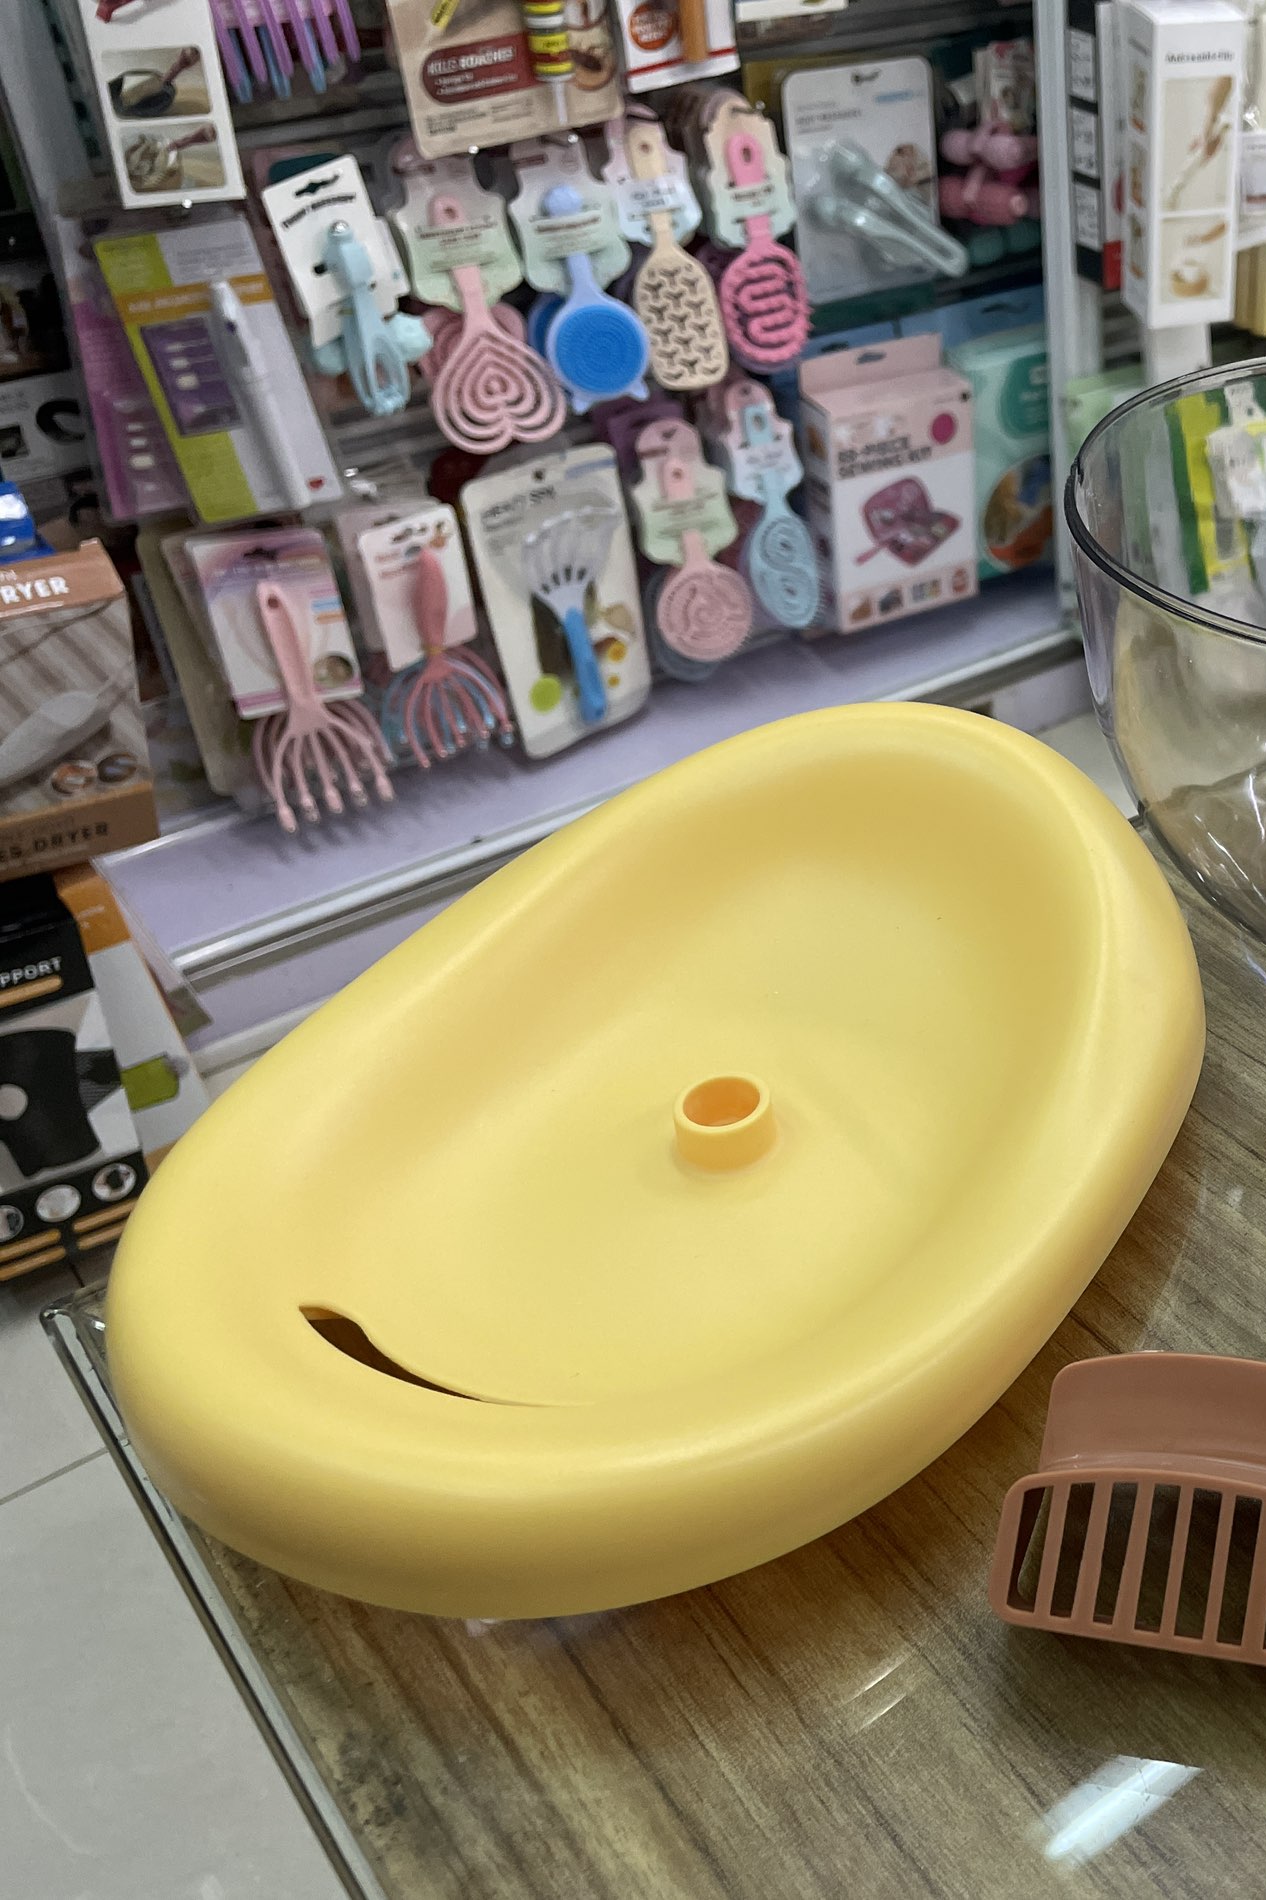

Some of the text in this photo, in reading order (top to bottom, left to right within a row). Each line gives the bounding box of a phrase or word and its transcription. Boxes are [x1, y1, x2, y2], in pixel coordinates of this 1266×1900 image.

[0, 576, 70, 604] RYER
[33, 822, 108, 852] DRYER
[0, 956, 62, 988] PPORT
